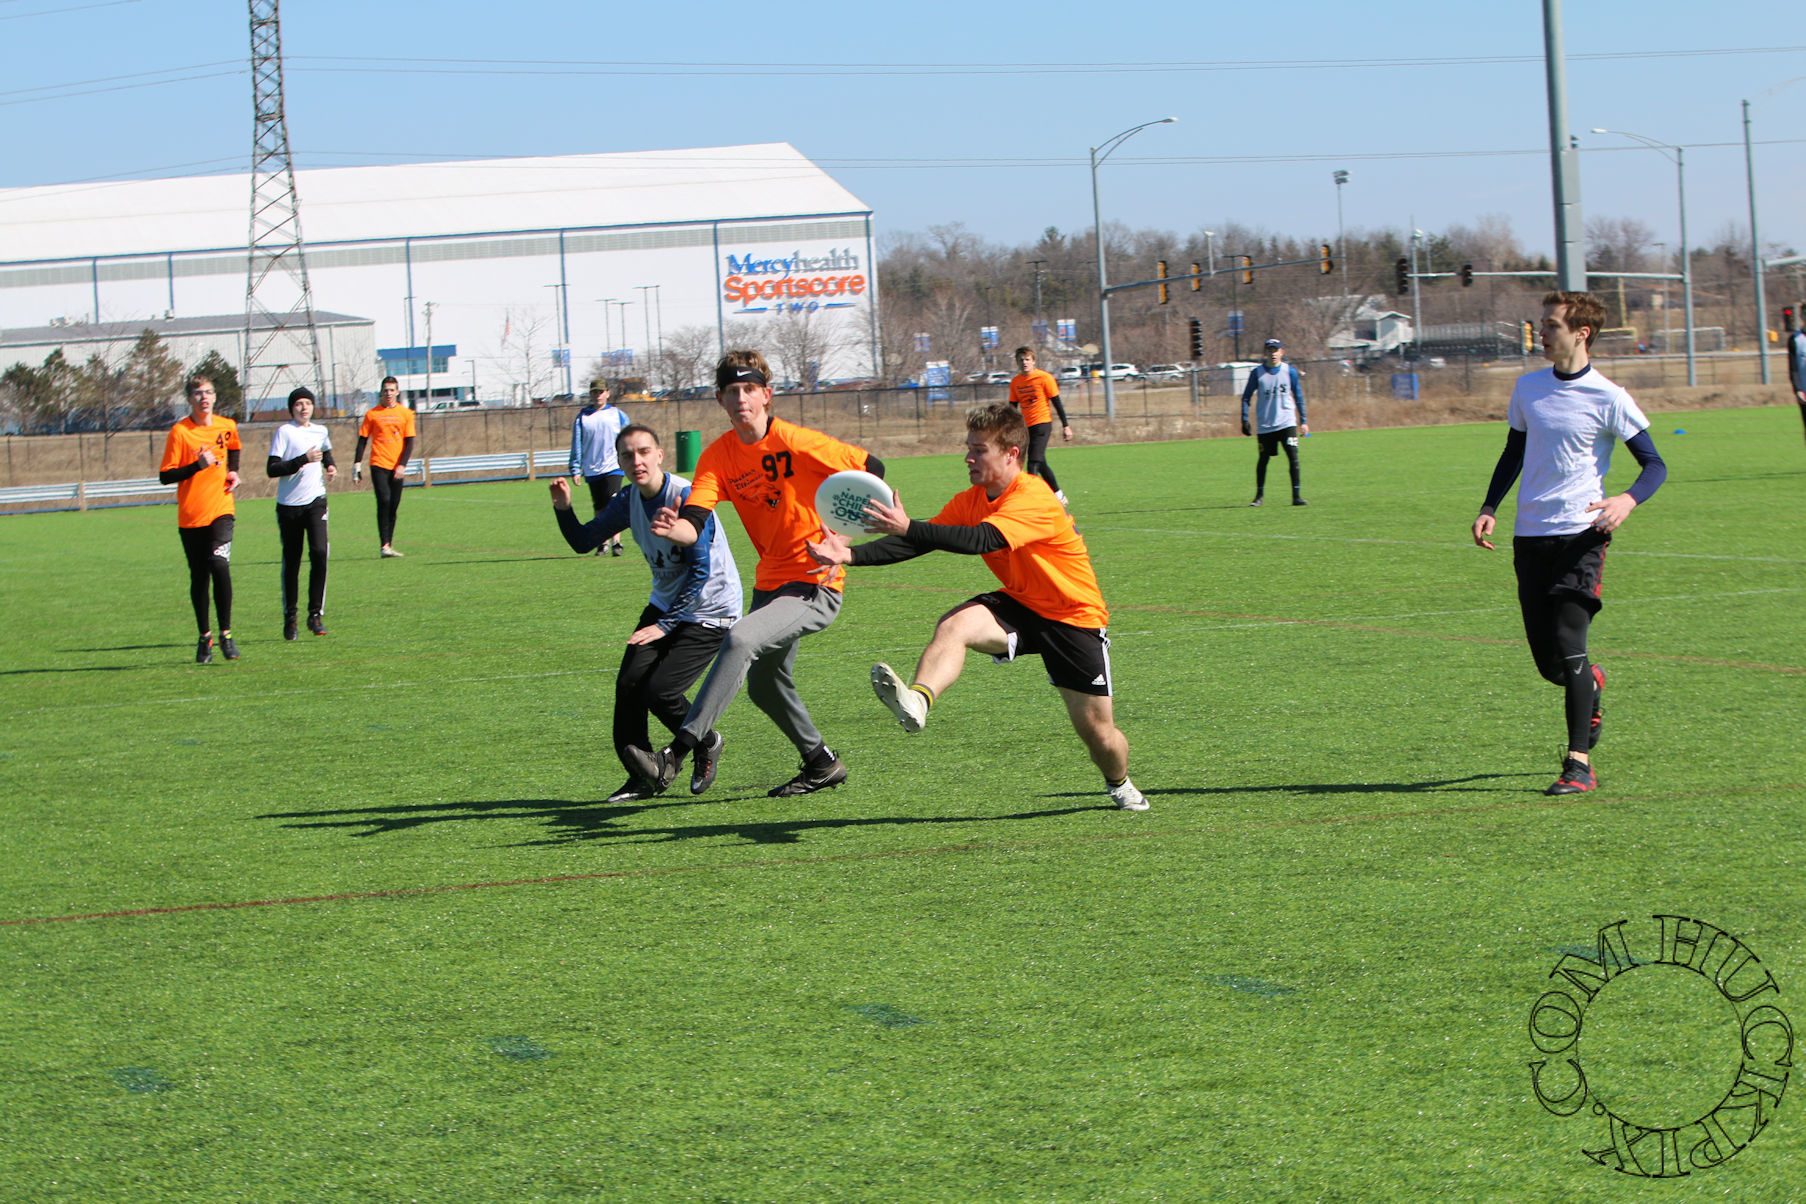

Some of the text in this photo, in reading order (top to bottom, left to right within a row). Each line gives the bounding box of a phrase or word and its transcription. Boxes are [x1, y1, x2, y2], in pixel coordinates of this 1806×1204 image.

[727, 248, 859, 278] Mercyhealth
[724, 274, 866, 306] Sportscore
[776, 301, 820, 314] TWO
[762, 450, 794, 482] 97
[835, 506, 871, 521] OU
[839, 498, 874, 512] CHIL
